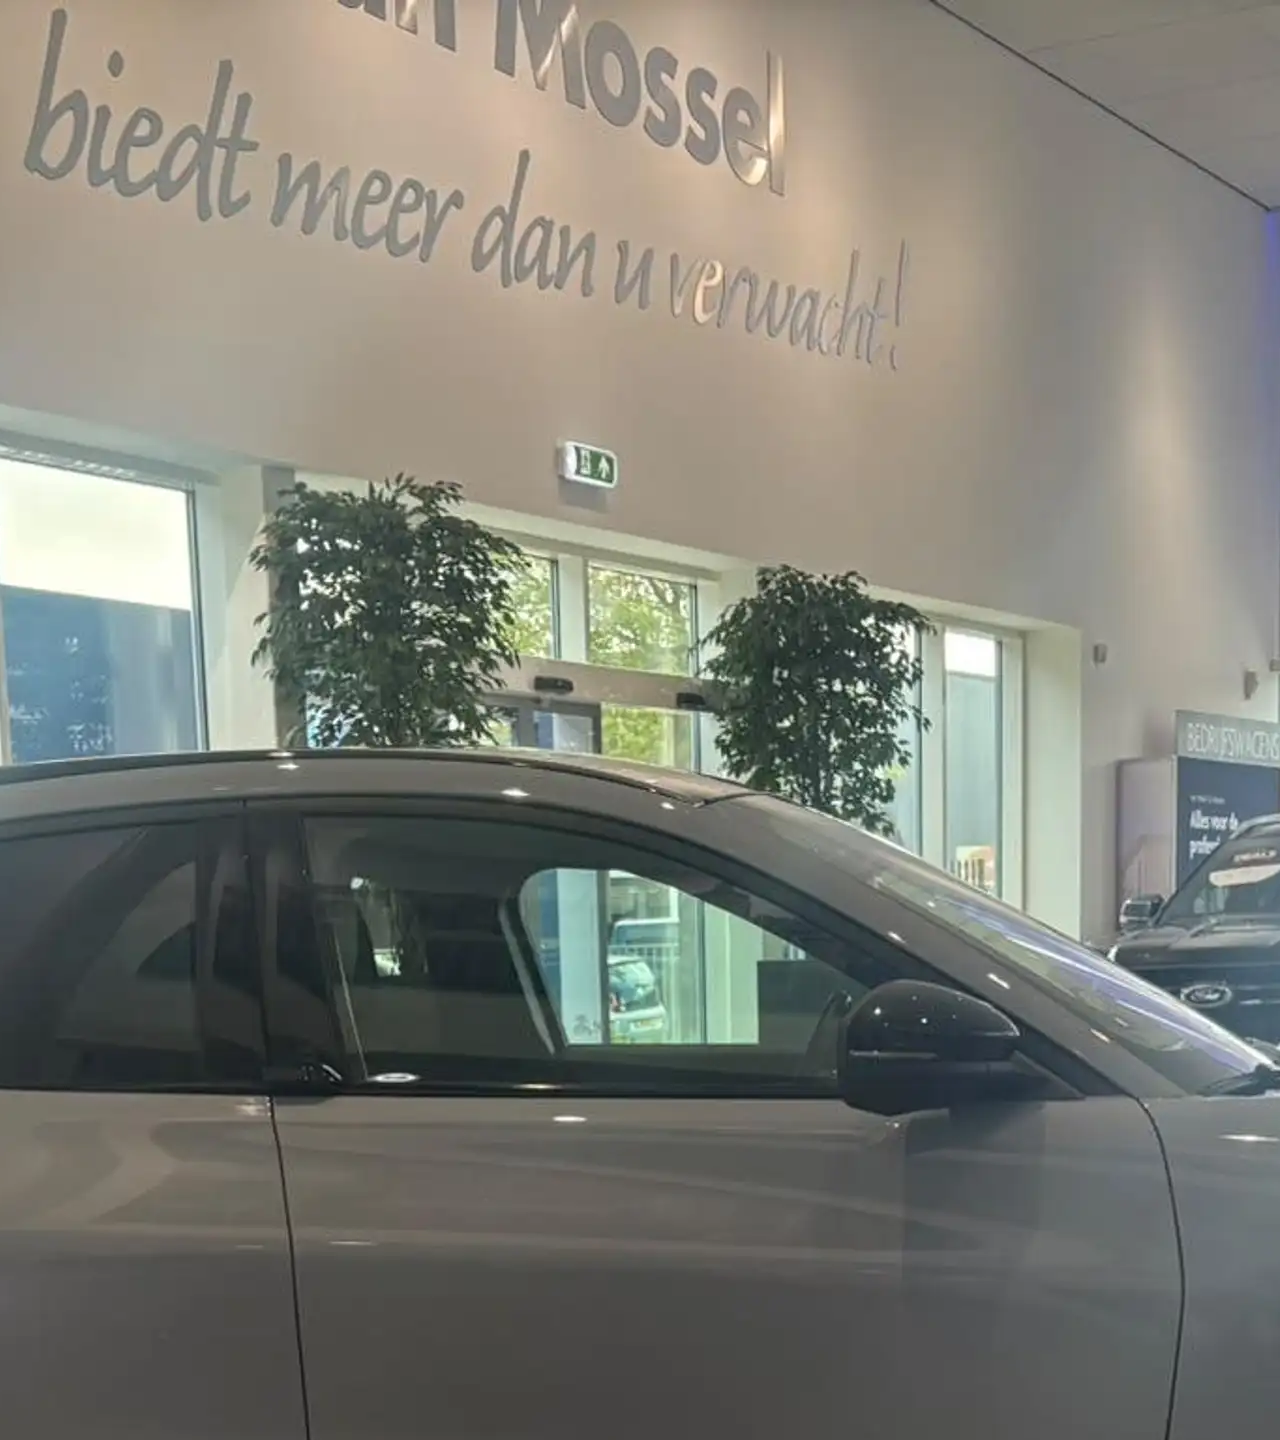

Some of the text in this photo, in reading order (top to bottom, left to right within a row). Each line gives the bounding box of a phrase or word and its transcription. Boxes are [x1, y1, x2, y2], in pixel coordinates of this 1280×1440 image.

[22, 7, 911, 372] biedt meer dan u verwacht!
[493, 0, 787, 196] Mossel
